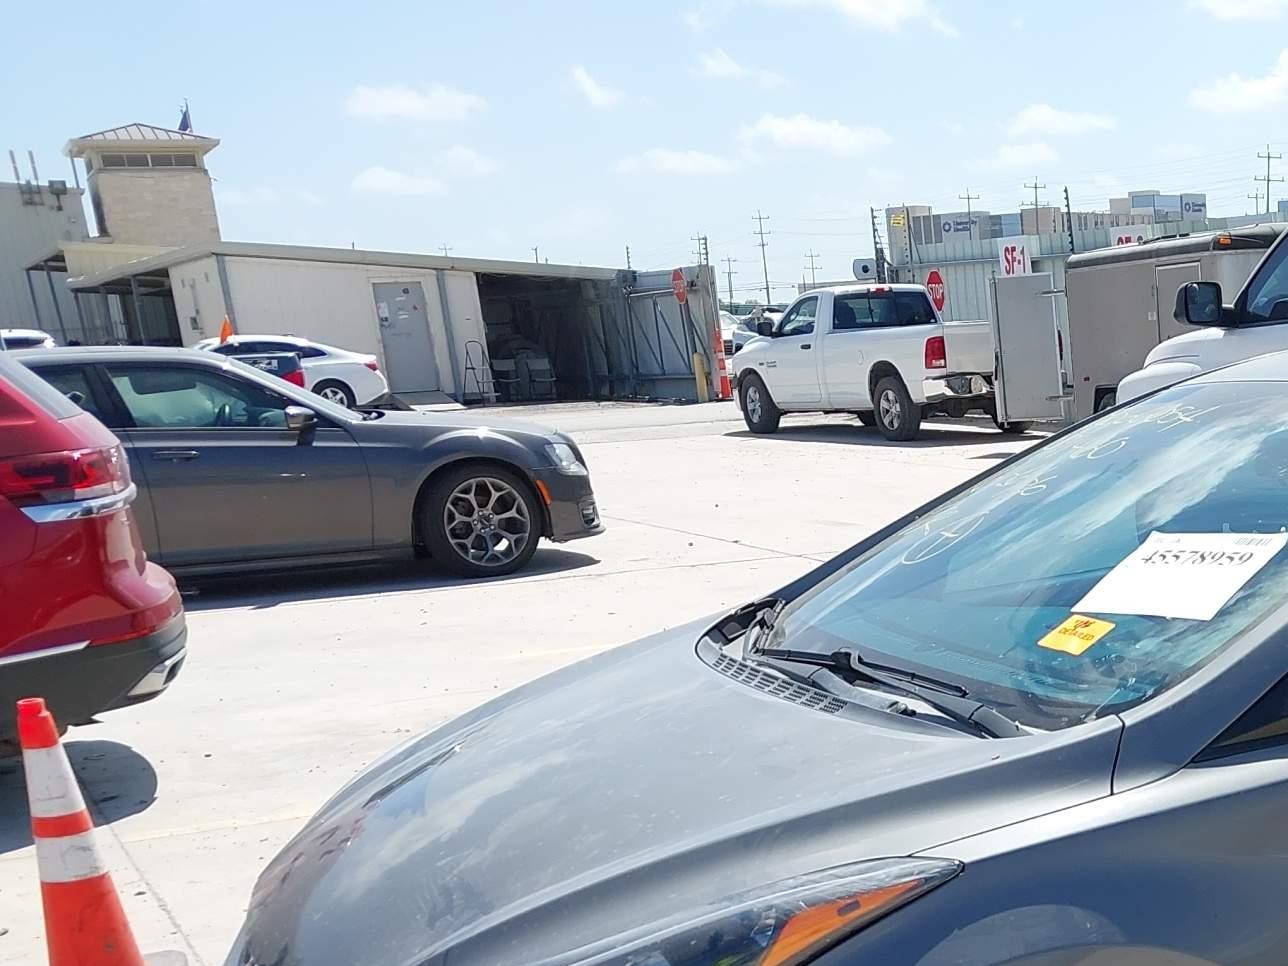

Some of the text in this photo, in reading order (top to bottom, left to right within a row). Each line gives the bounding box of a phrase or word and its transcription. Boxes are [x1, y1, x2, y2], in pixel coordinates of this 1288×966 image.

[1003, 244, 1026, 275] SF-1
[927, 283, 944, 299] STOP
[1140, 549, 1255, 566] 45578959
